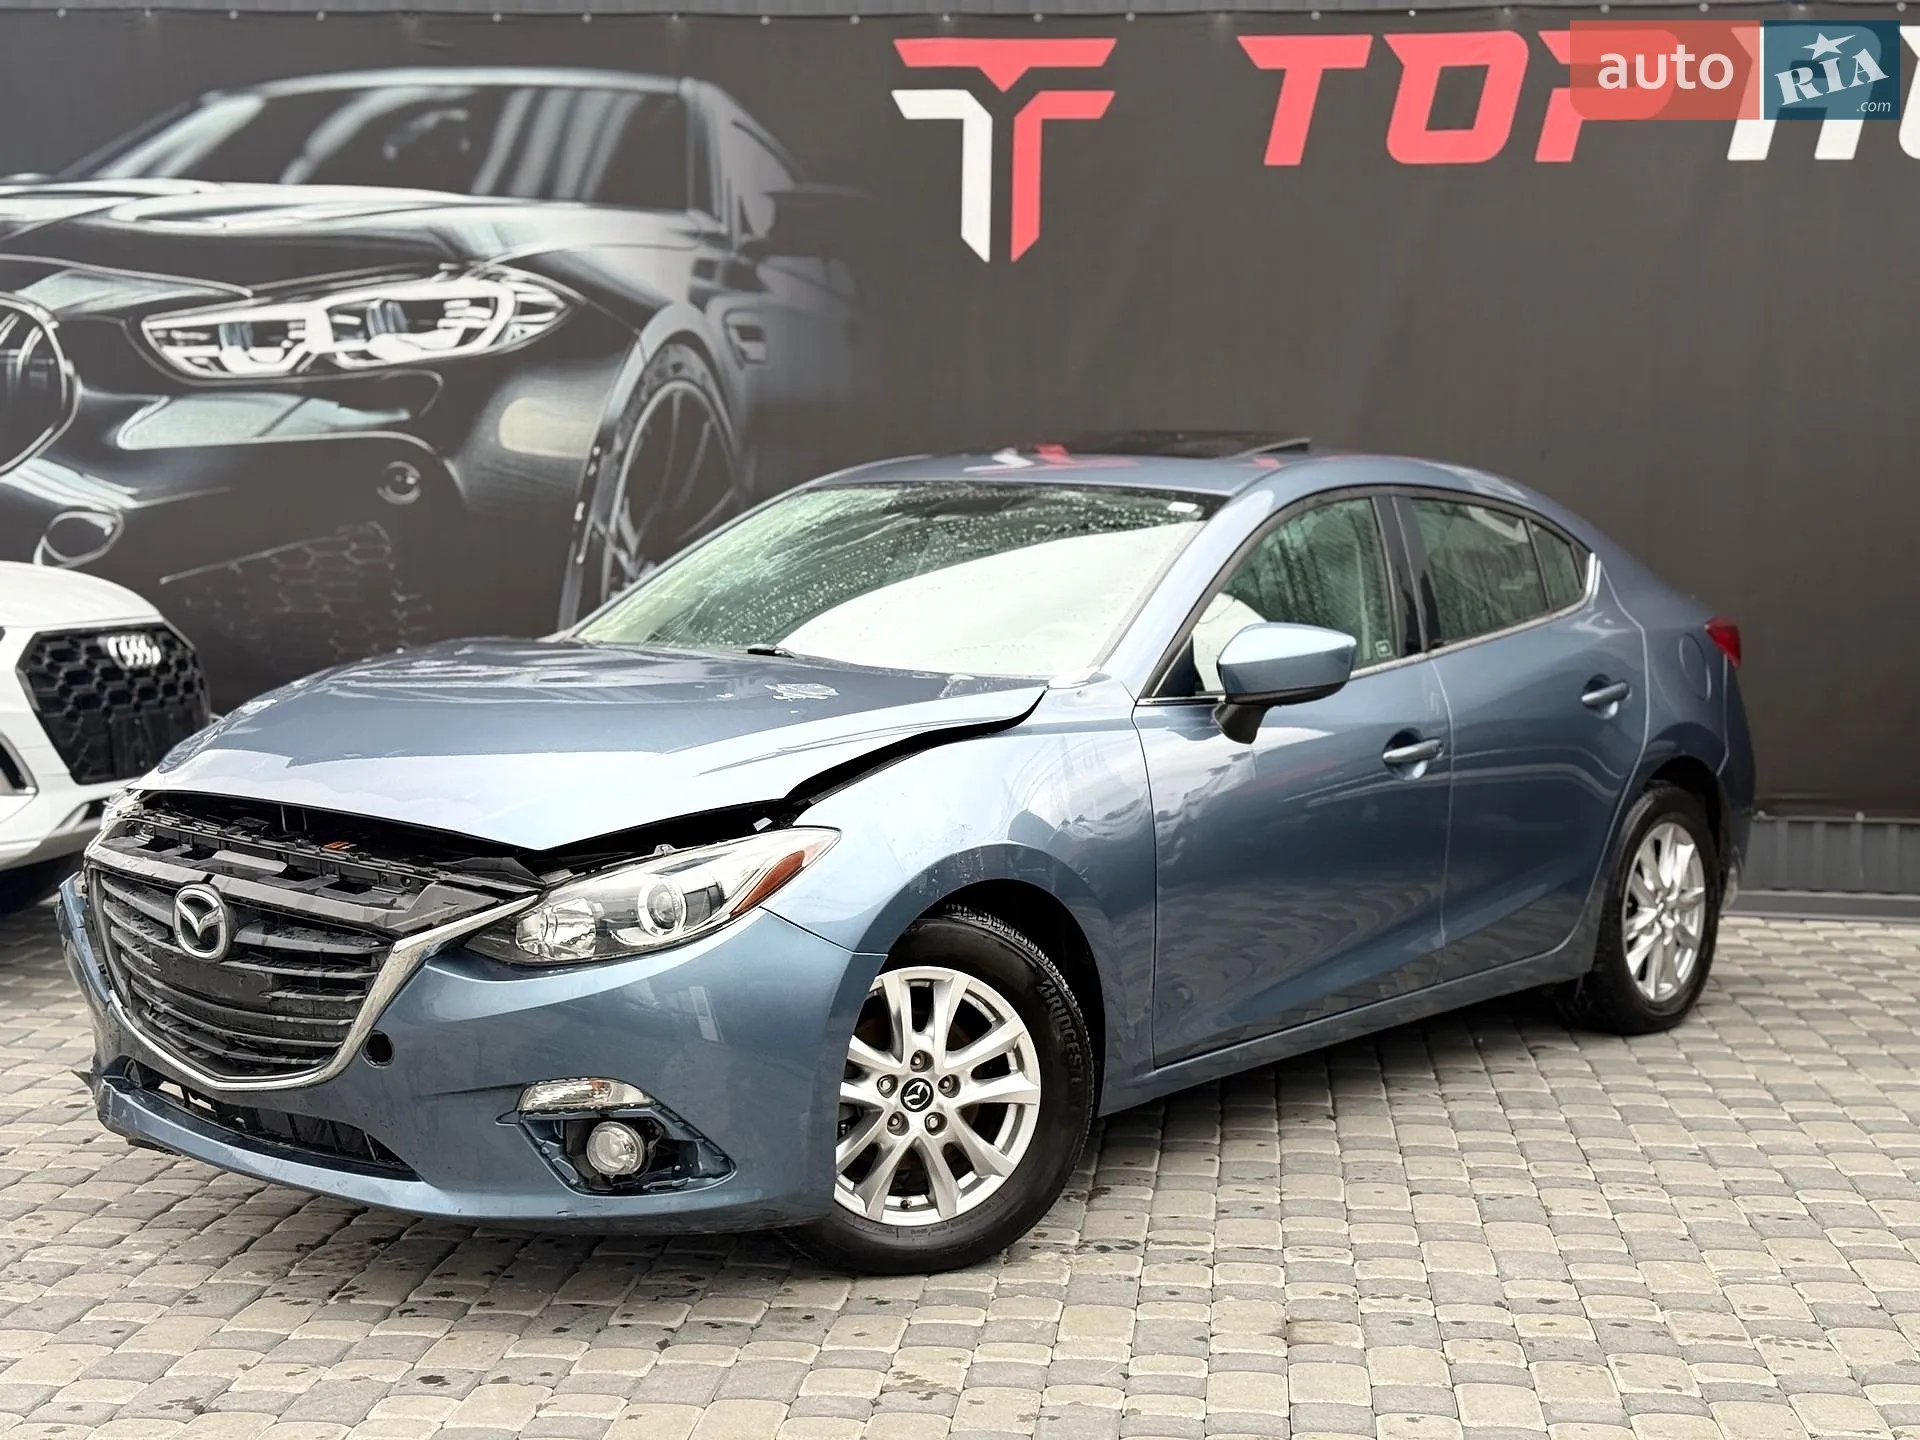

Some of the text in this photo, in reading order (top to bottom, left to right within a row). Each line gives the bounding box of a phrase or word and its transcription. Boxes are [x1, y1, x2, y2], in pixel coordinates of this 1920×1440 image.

[1237, 25, 1920, 165] TOP A
[1036, 979, 1085, 1110] BRIDGEST
